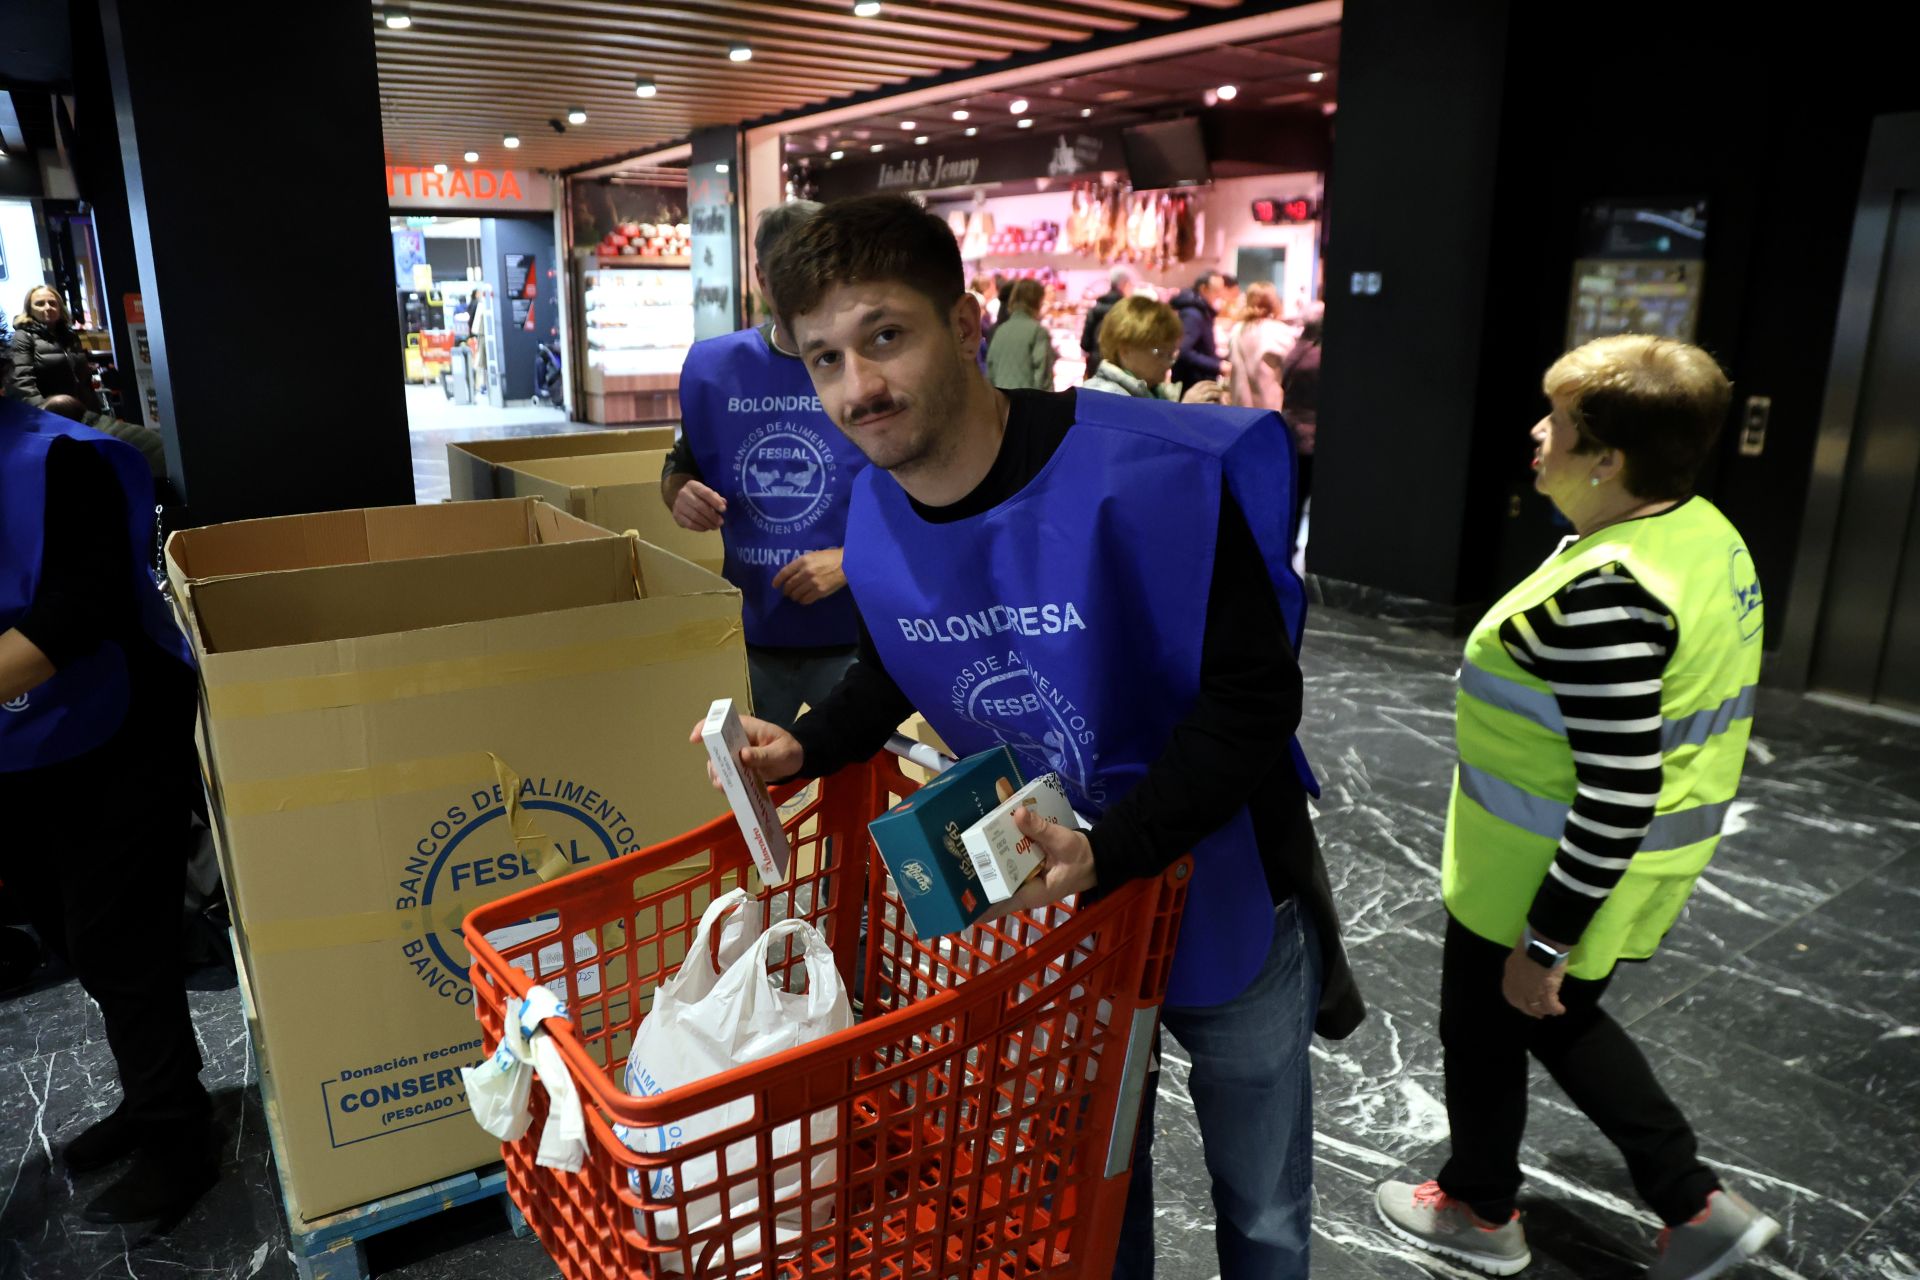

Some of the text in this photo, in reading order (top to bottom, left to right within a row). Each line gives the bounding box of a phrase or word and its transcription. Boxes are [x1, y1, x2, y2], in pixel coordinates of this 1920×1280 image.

[931, 154, 980, 188] Jenny
[728, 395, 823, 413] BOLONDRE
[733, 421, 837, 472] BANCOS DE ALIMENTOS
[758, 447, 810, 460] FESBAL
[793, 491, 834, 533] BANKUA
[736, 547, 811, 566] VOLUNTA
[897, 602, 1087, 643] BOLONDRESA
[973, 655, 1002, 677] DE
[981, 692, 1043, 717] FESB
[396, 805, 467, 911] BANCOS
[519, 777, 641, 857] ALIMENTOS
[401, 938, 474, 1006] BANCO
[340, 1056, 419, 1082] Donación
[423, 1038, 485, 1062] recome
[381, 1096, 454, 1126] (PESCADO
